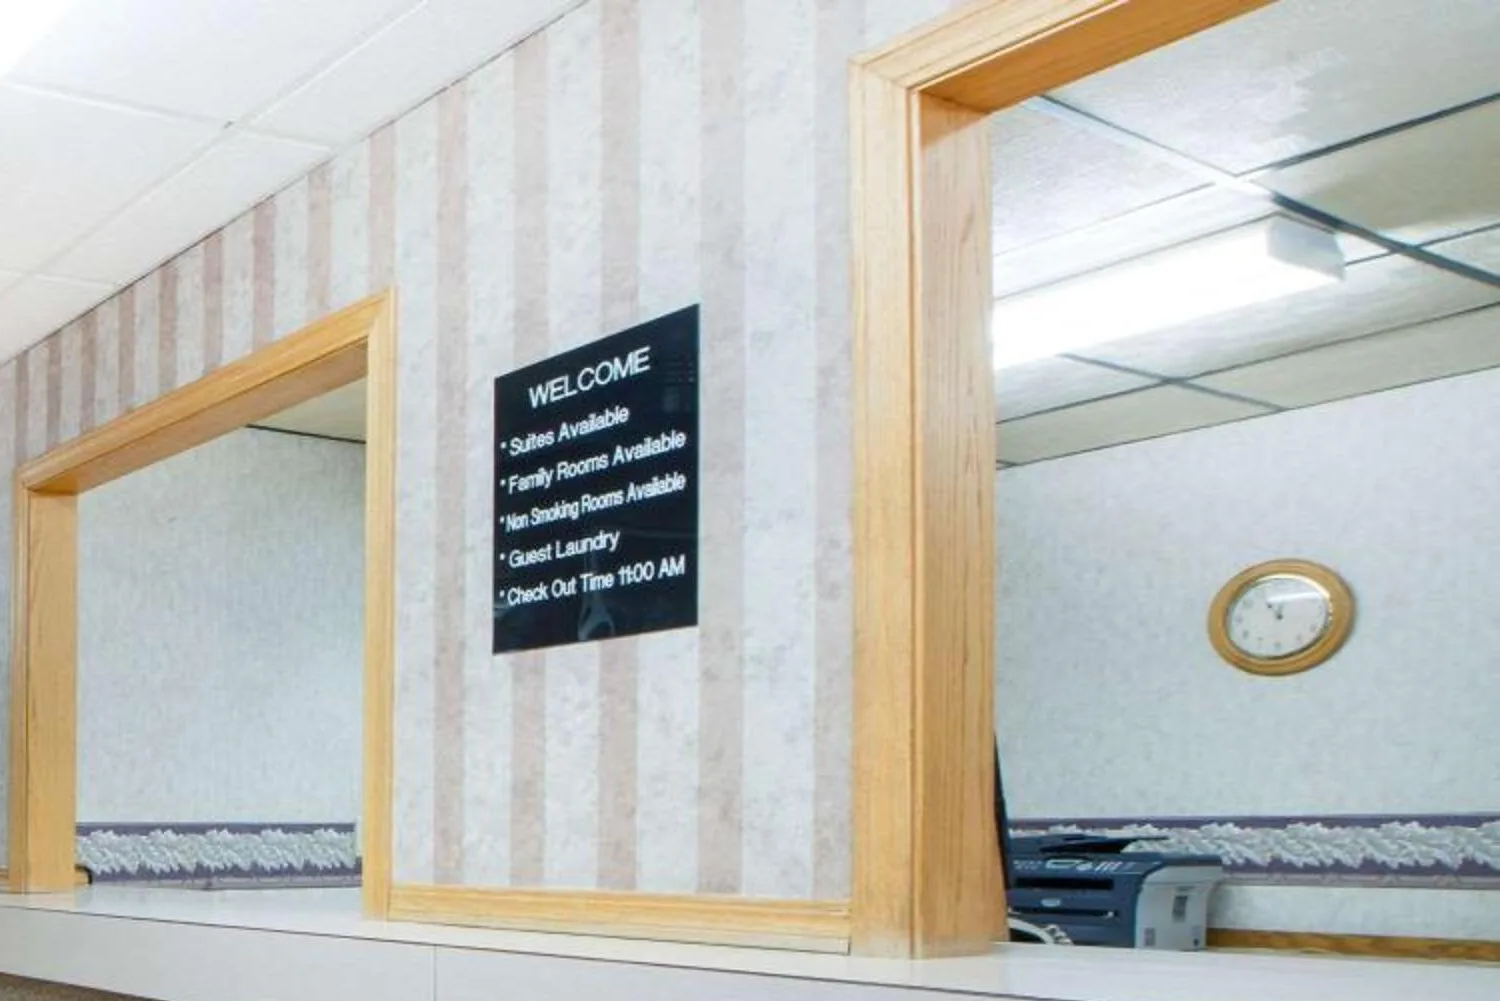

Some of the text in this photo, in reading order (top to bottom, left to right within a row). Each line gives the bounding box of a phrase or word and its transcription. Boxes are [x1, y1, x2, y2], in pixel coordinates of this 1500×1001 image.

[528, 345, 651, 409] WELCOME
[509, 405, 631, 457] Suites Available
[508, 429, 687, 494] Family Rooms Available
[505, 471, 687, 534] Non Smoking Rooms Available
[509, 529, 621, 569] Guest Laundry
[507, 583, 549, 607] Check
[551, 576, 577, 599] Out
[580, 571, 615, 593] Time
[657, 553, 687, 580] AM
